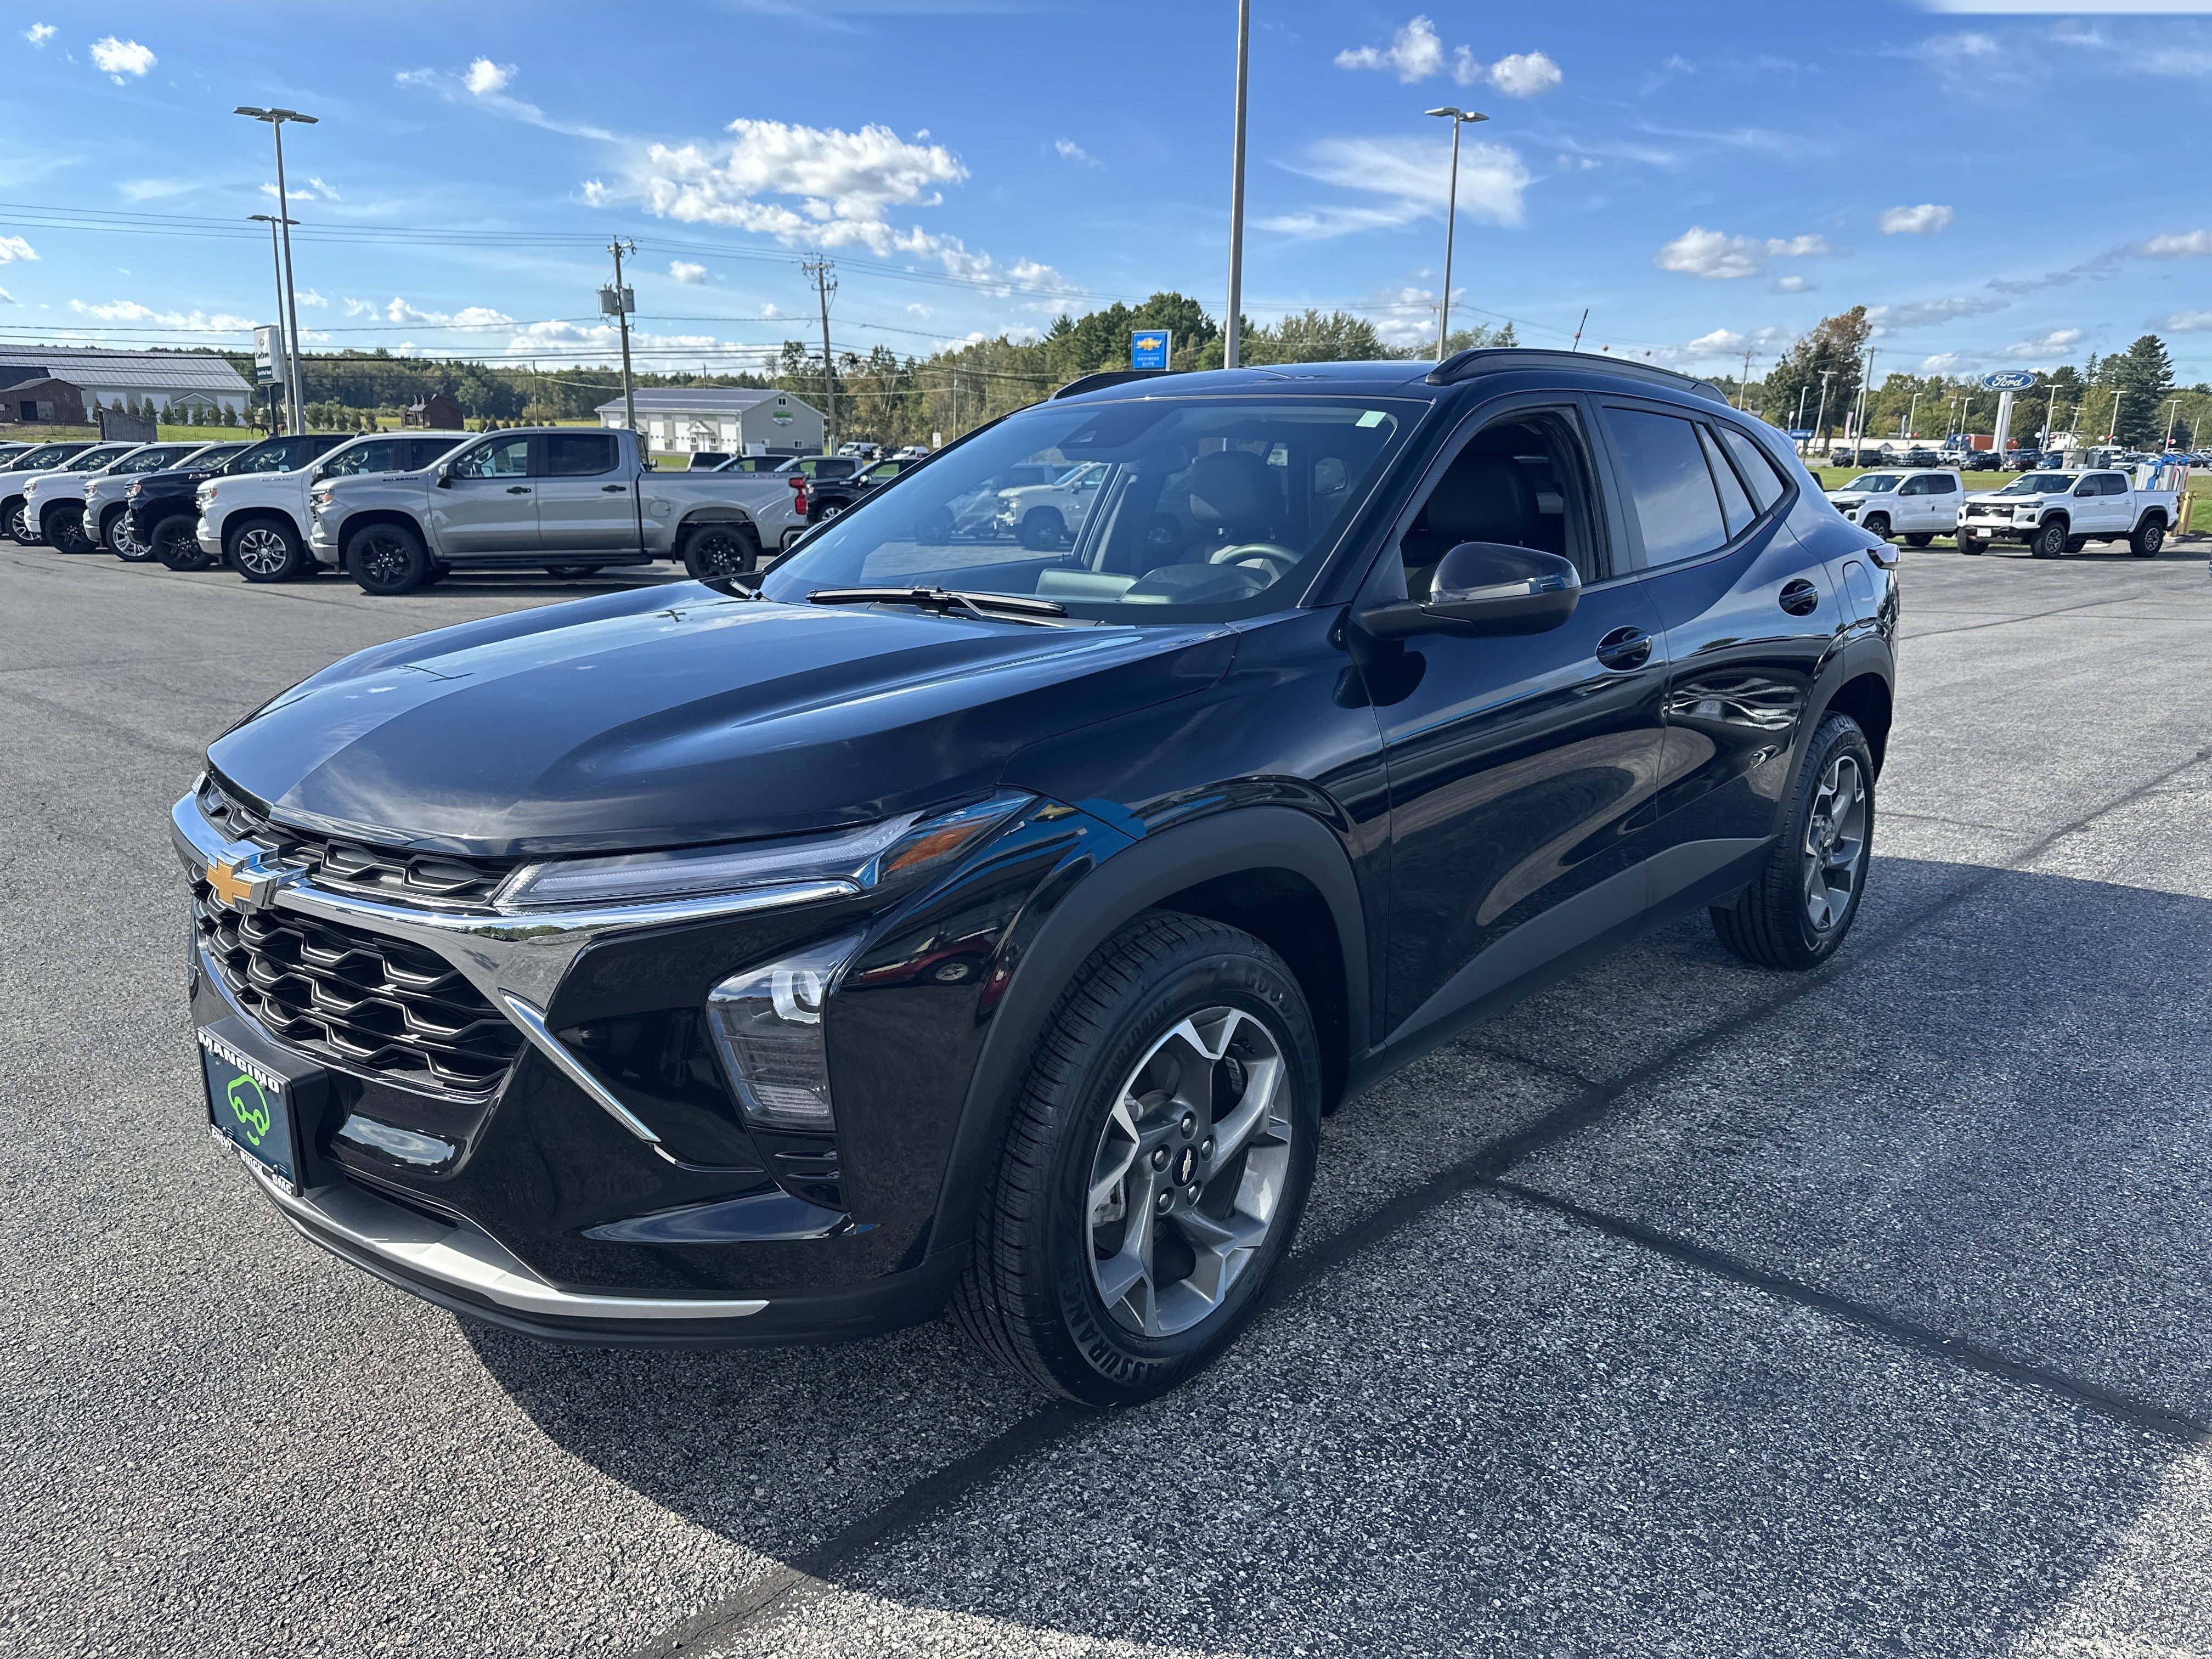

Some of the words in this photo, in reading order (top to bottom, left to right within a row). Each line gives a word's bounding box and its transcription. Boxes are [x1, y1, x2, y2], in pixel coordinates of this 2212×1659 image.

[1991, 374, 2024, 387] Ford
[198, 1031, 280, 1093] MANGINO
[211, 1128, 233, 1150] CHEVY
[240, 1150, 264, 1176] BUICK
[272, 1173, 292, 1195] GMC
